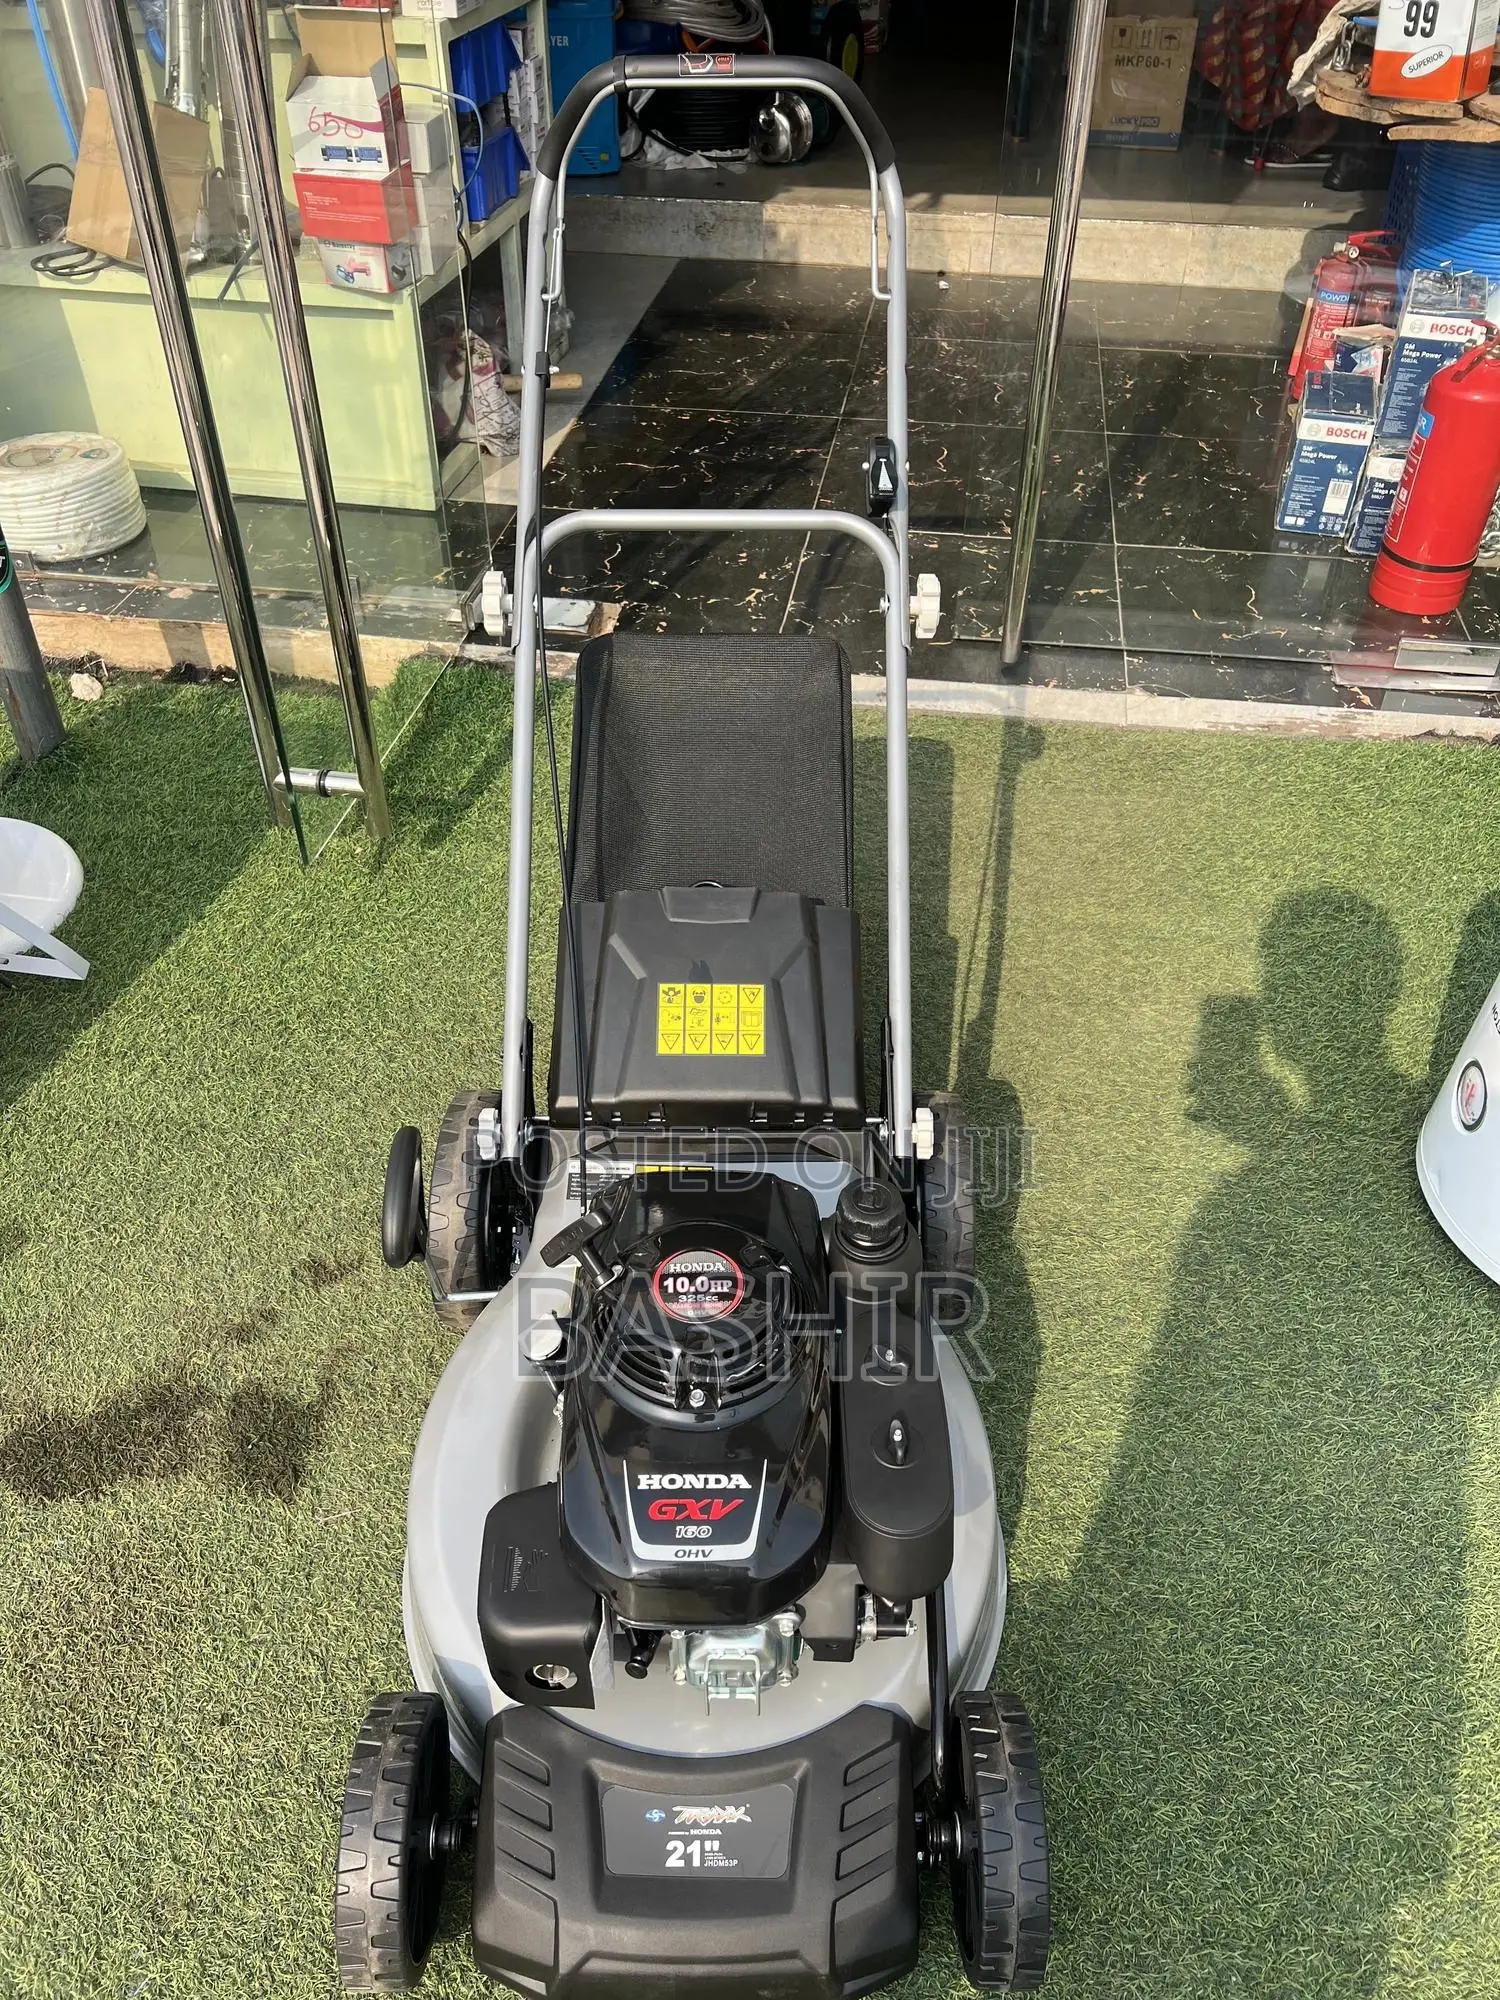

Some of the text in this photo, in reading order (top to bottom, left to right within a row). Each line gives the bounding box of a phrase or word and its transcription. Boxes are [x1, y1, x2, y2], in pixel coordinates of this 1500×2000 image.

[549, 36, 569, 47] YER
[1114, 54, 1173, 69] MKP60-1
[1408, 50, 1445, 73] SUPERIOR
[307, 106, 364, 140] 650
[1430, 322, 1475, 337] BOSCH
[1404, 342, 1416, 350] SM
[1402, 349, 1442, 360] Mega Power
[1326, 427, 1368, 440] BOSCH
[1301, 451, 1338, 460] Mega Power
[1373, 487, 1389, 495] Mega
[669, 1262, 726, 1272] HONDA
[678, 1294, 719, 1302] 325cc
[637, 1474, 752, 1490] HONDA
[647, 1498, 745, 1521] GXV
[675, 1525, 712, 1539] 160
[674, 1548, 713, 1559] OHV
